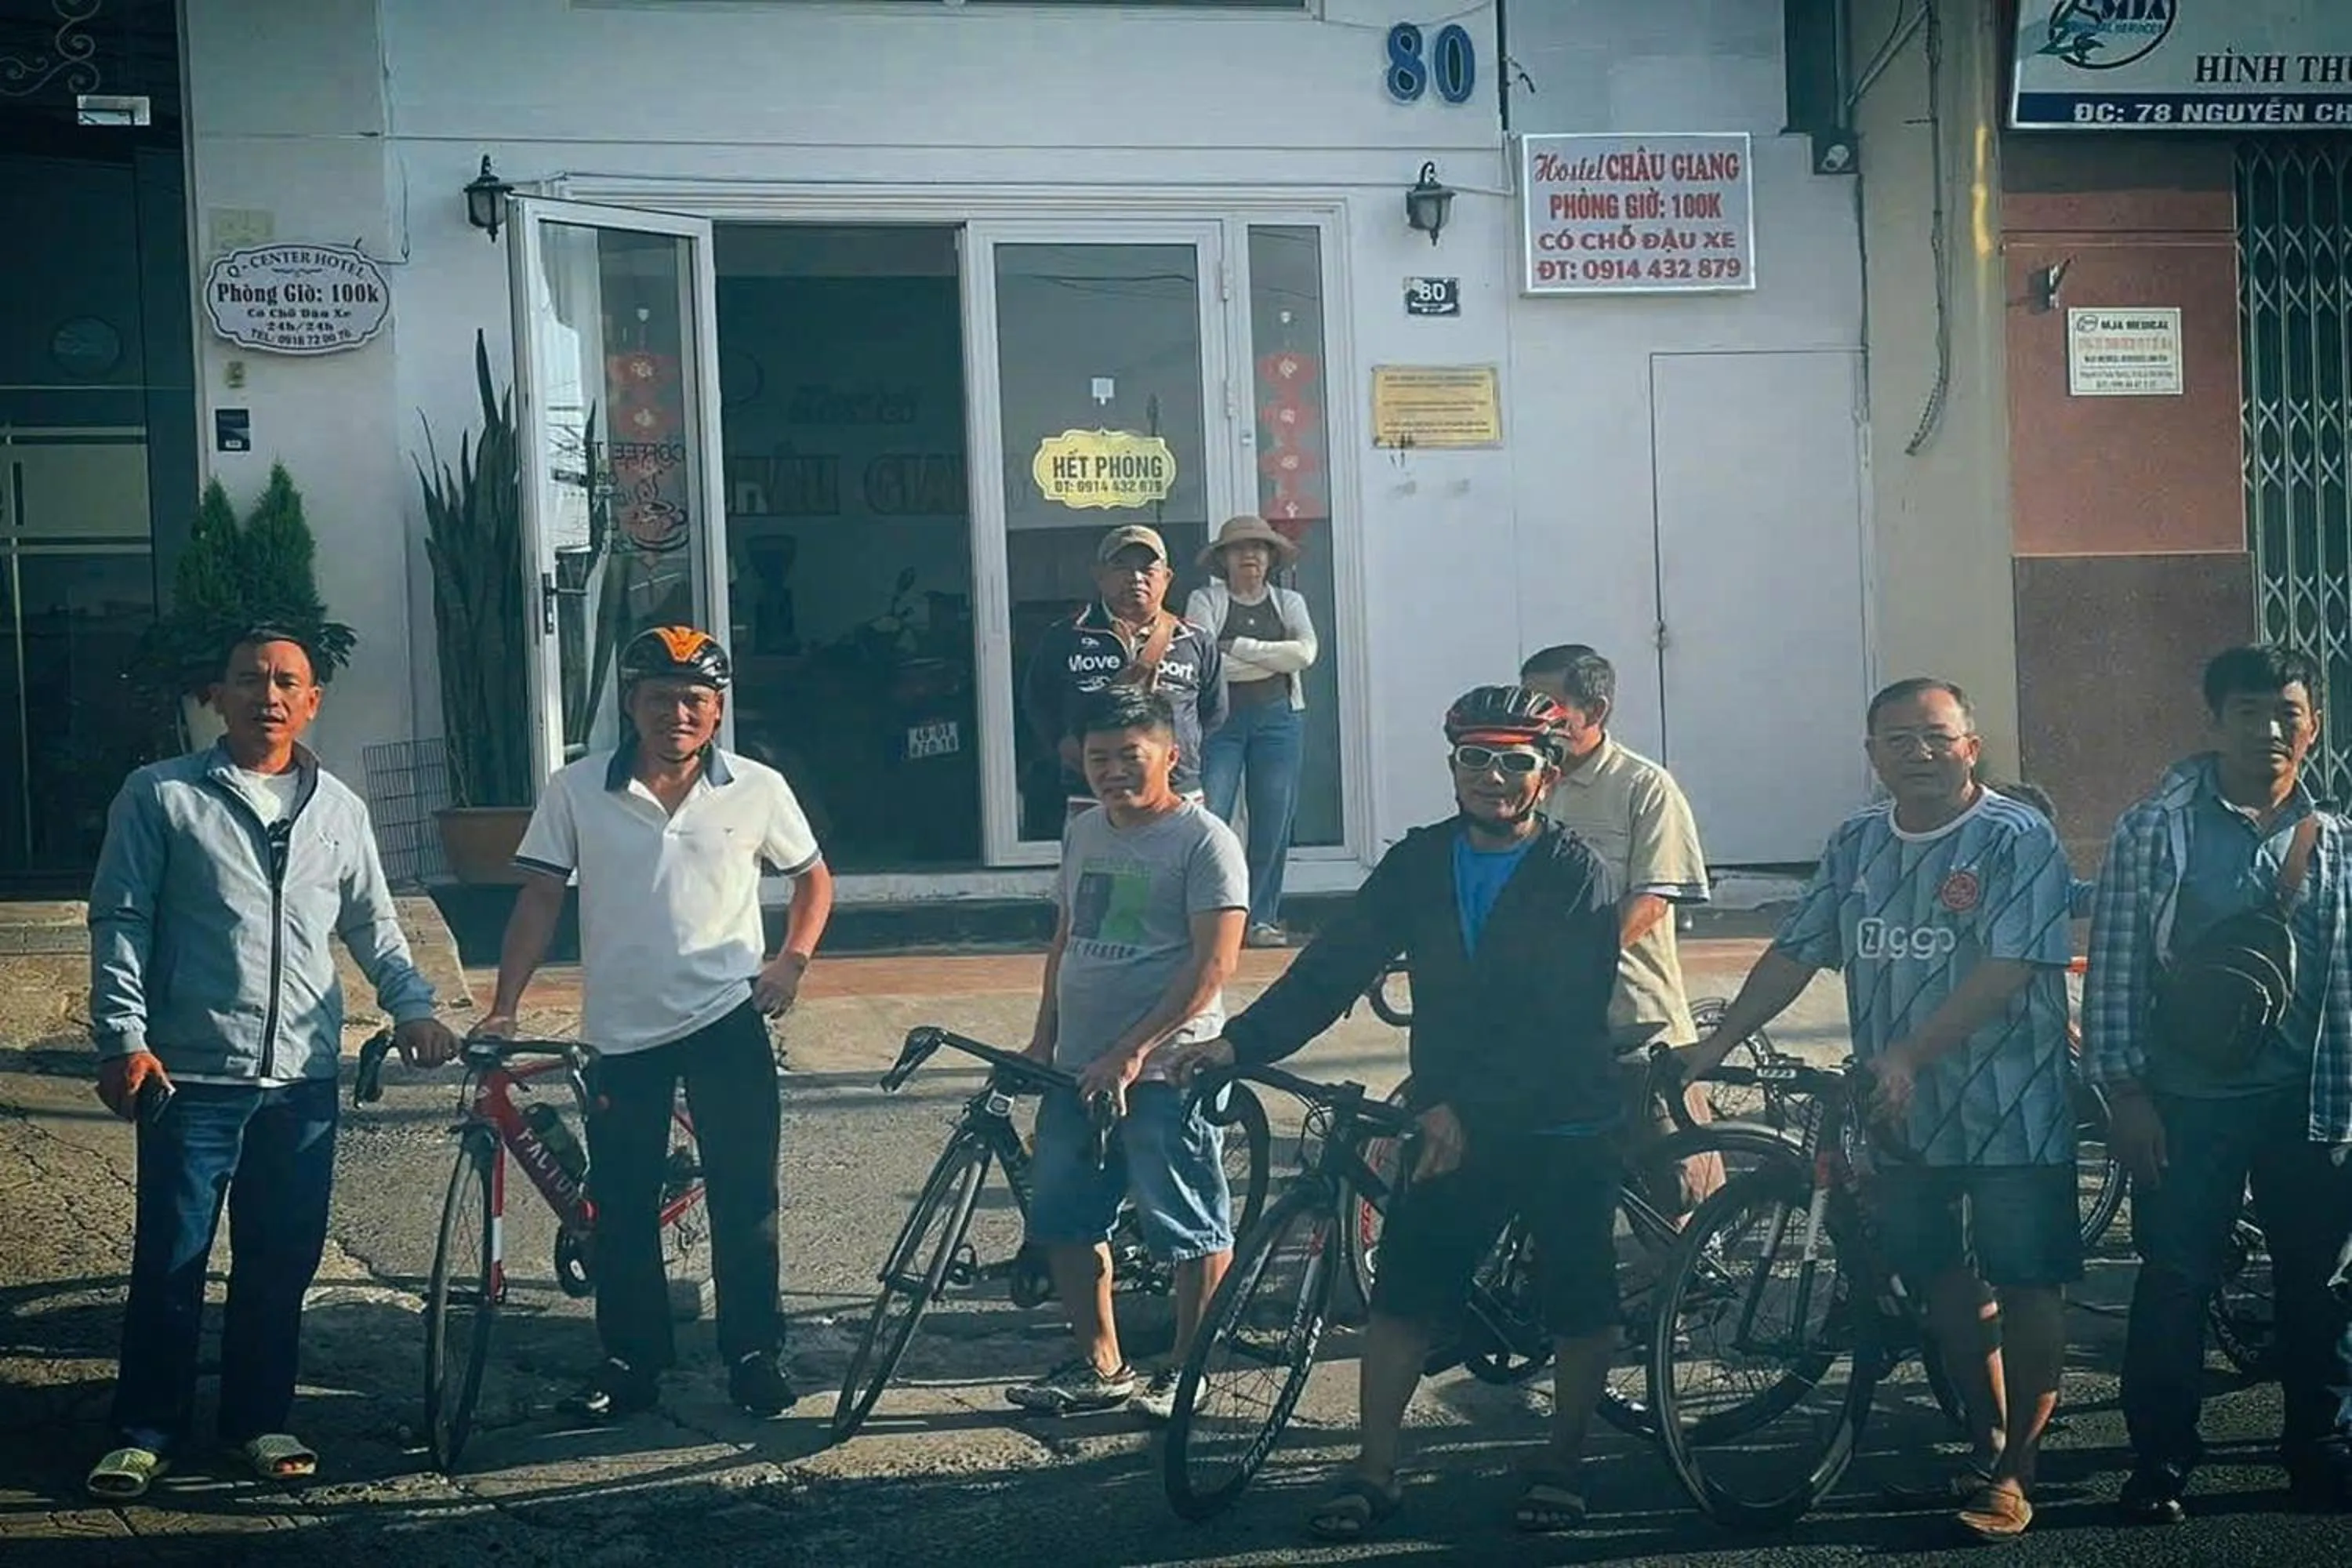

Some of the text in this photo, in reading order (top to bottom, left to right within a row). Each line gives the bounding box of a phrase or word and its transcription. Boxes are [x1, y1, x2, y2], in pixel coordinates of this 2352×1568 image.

[1386, 22, 1475, 103] 80
[2196, 47, 2352, 82] HÌNH TH
[2074, 103, 2125, 122] ĐC:
[2134, 103, 2172, 122] 78
[2181, 96, 2306, 122] NGUYỄN
[1534, 146, 1740, 181] Hostel CHÂU GIANG
[1550, 187, 1620, 220] PHÒNG
[1671, 193, 1722, 219] 100K
[1538, 227, 1575, 250] CÓ
[1581, 224, 1636, 250] CHỖ
[1704, 232, 1736, 249] XE
[250, 252, 311, 268] CENTER
[1537, 258, 1741, 280] ĐT: 0914 432 879
[217, 283, 278, 306] Phòng
[332, 284, 379, 303] 100k
[1053, 448, 1088, 478] HẾT
